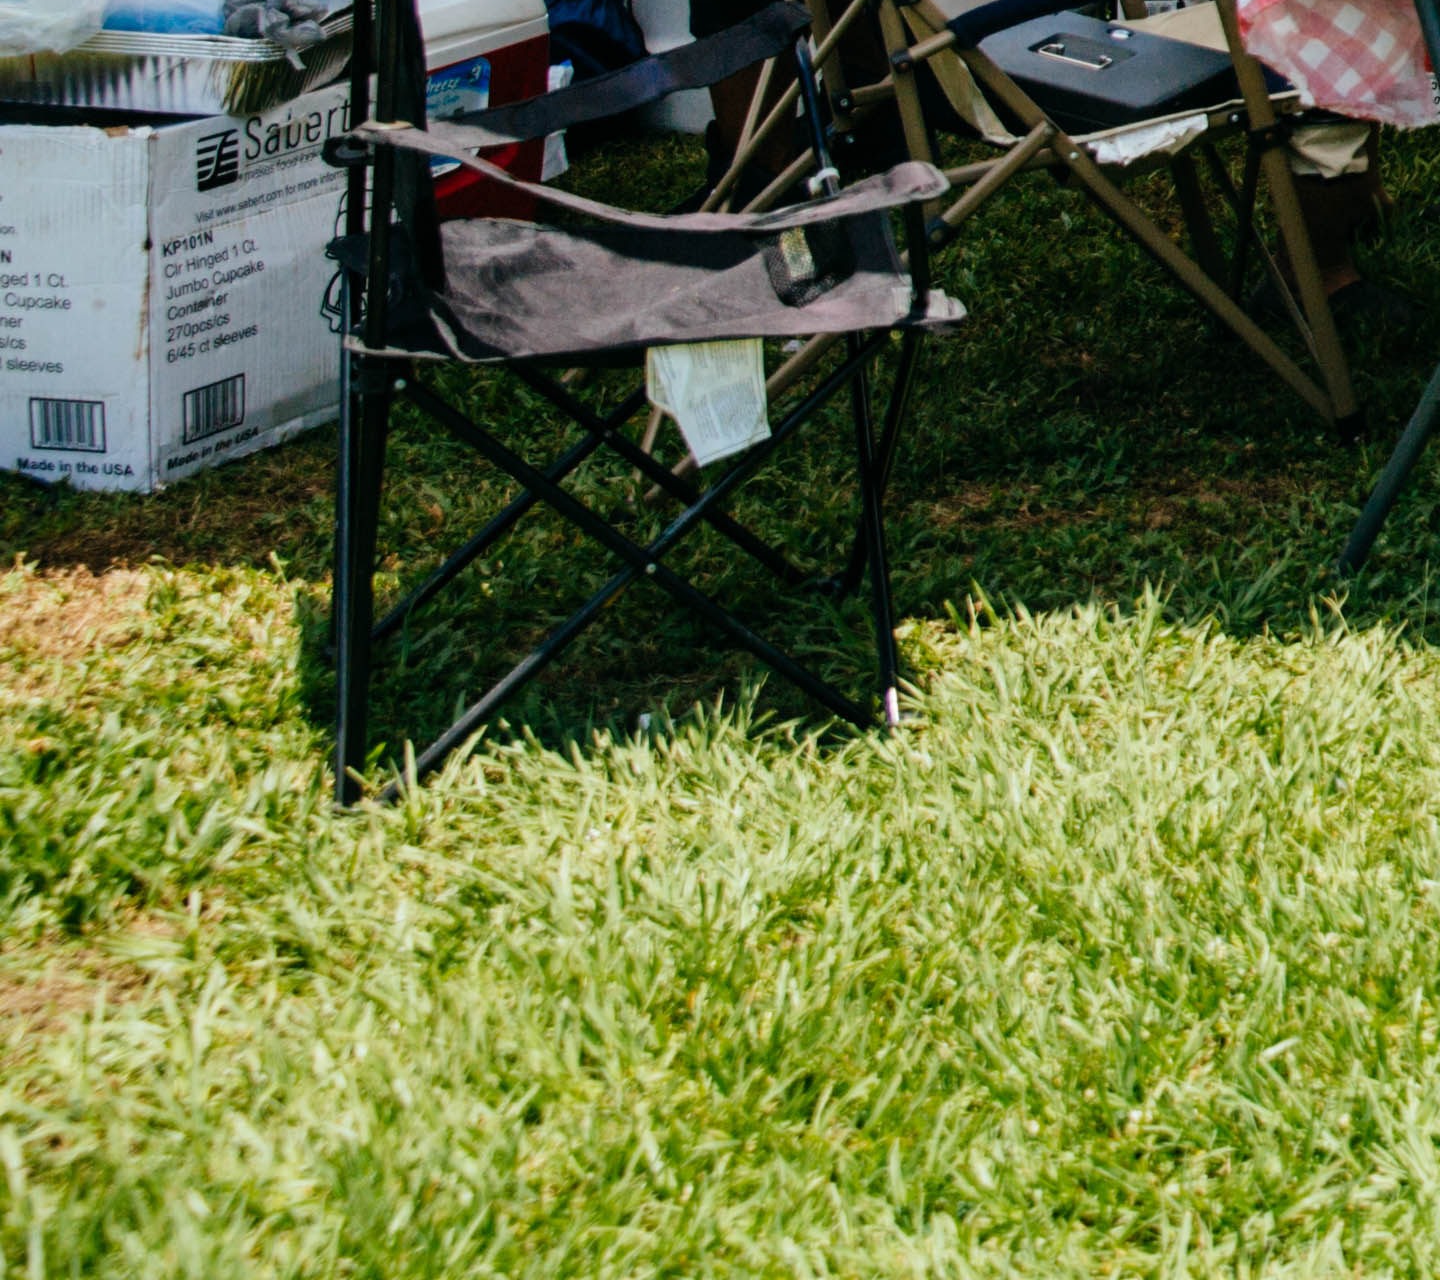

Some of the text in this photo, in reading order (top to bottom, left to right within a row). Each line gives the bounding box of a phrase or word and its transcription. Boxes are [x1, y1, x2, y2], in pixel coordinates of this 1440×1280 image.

[244, 99, 351, 161] Sabert
[162, 230, 214, 258] KP101N
[187, 246, 230, 275] Hinged
[166, 259, 265, 301] Jumbo Cupcake
[5, 292, 72, 311] Cupcake
[167, 291, 229, 321] Container
[167, 312, 231, 343] 270pcs/cs
[167, 341, 196, 363] 6/45
[213, 322, 259, 349] sleeves
[6, 356, 65, 374] sleeves
[167, 425, 260, 470] Made in the USA
[17, 458, 135, 477] Made in the USA
